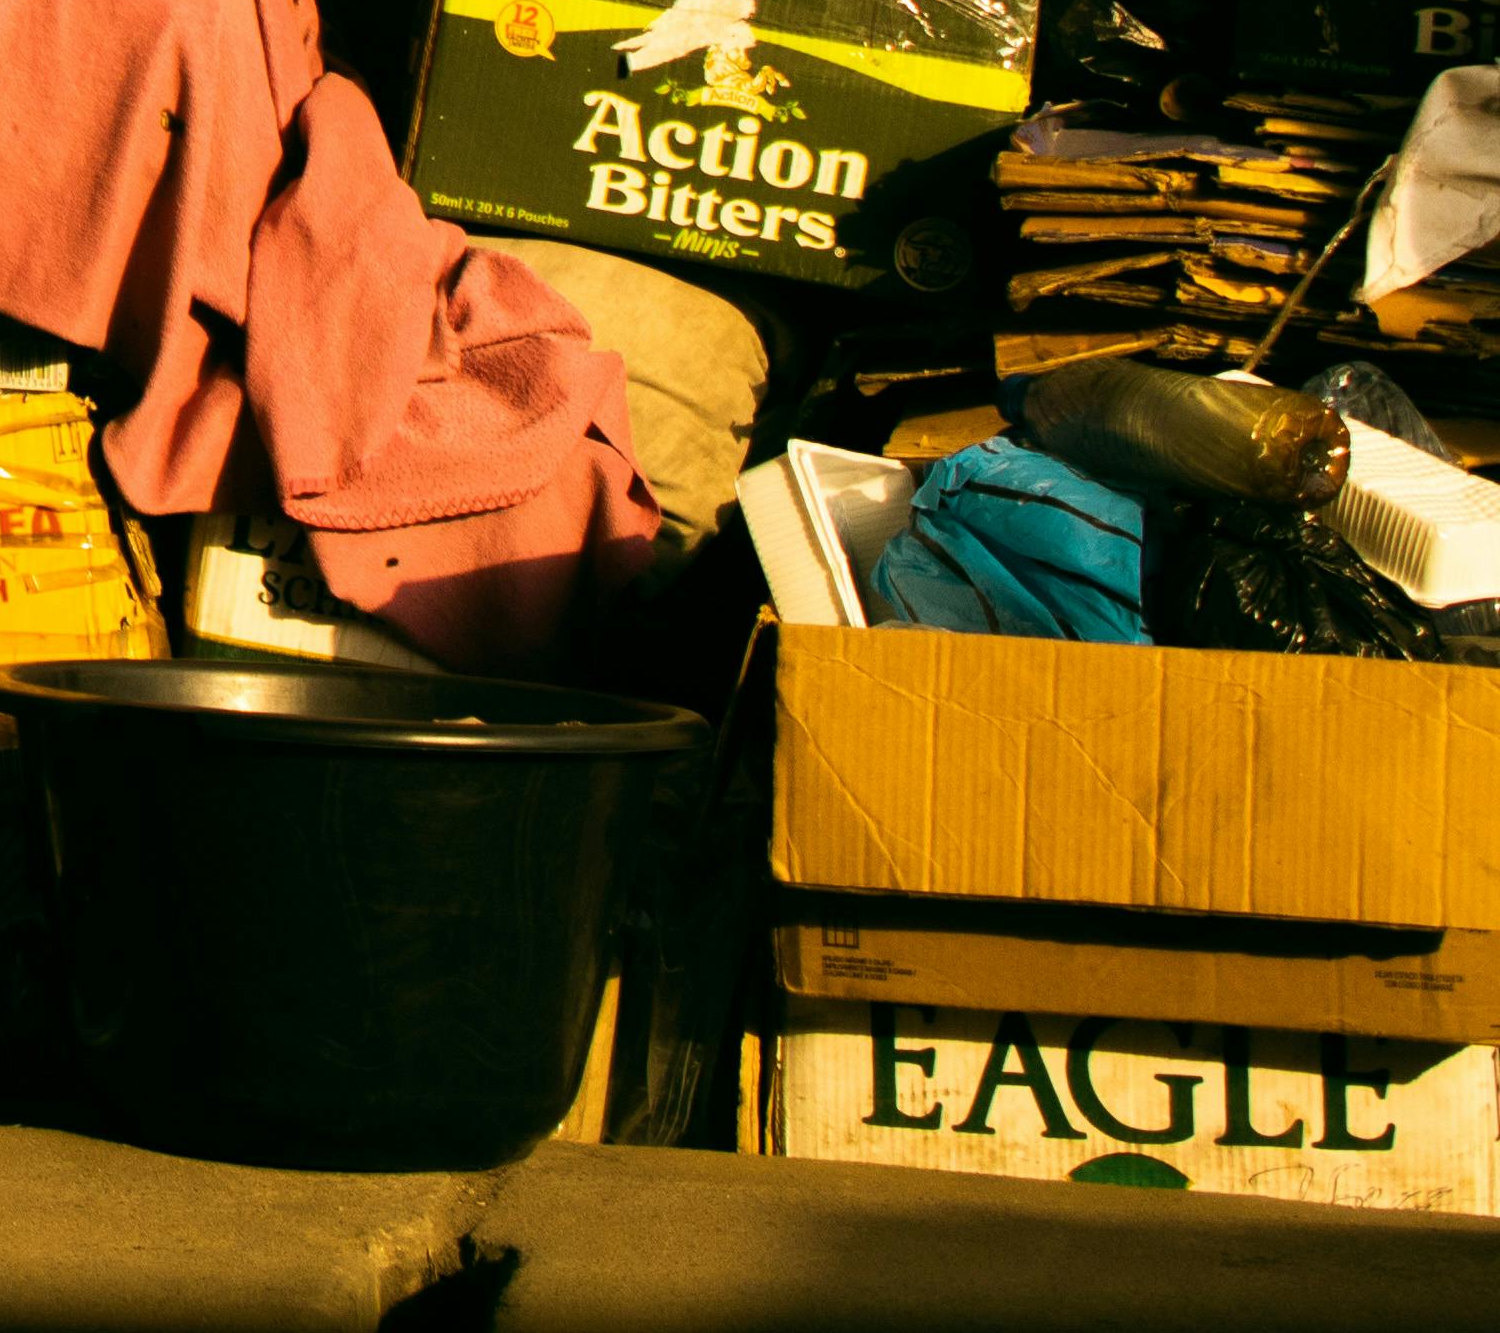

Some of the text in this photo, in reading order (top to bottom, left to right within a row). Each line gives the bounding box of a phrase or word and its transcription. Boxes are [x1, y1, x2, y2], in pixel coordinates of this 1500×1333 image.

[513, 3, 539, 27] 12
[573, 90, 870, 201] Action
[430, 192, 463, 210] 50ml
[476, 201, 493, 215] 20
[506, 206, 515, 220] 6
[517, 208, 571, 230] Pouches
[586, 162, 837, 251] Bitters
[673, 228, 740, 261] Minis
[862, 1003, 1398, 1152] EAGLE
